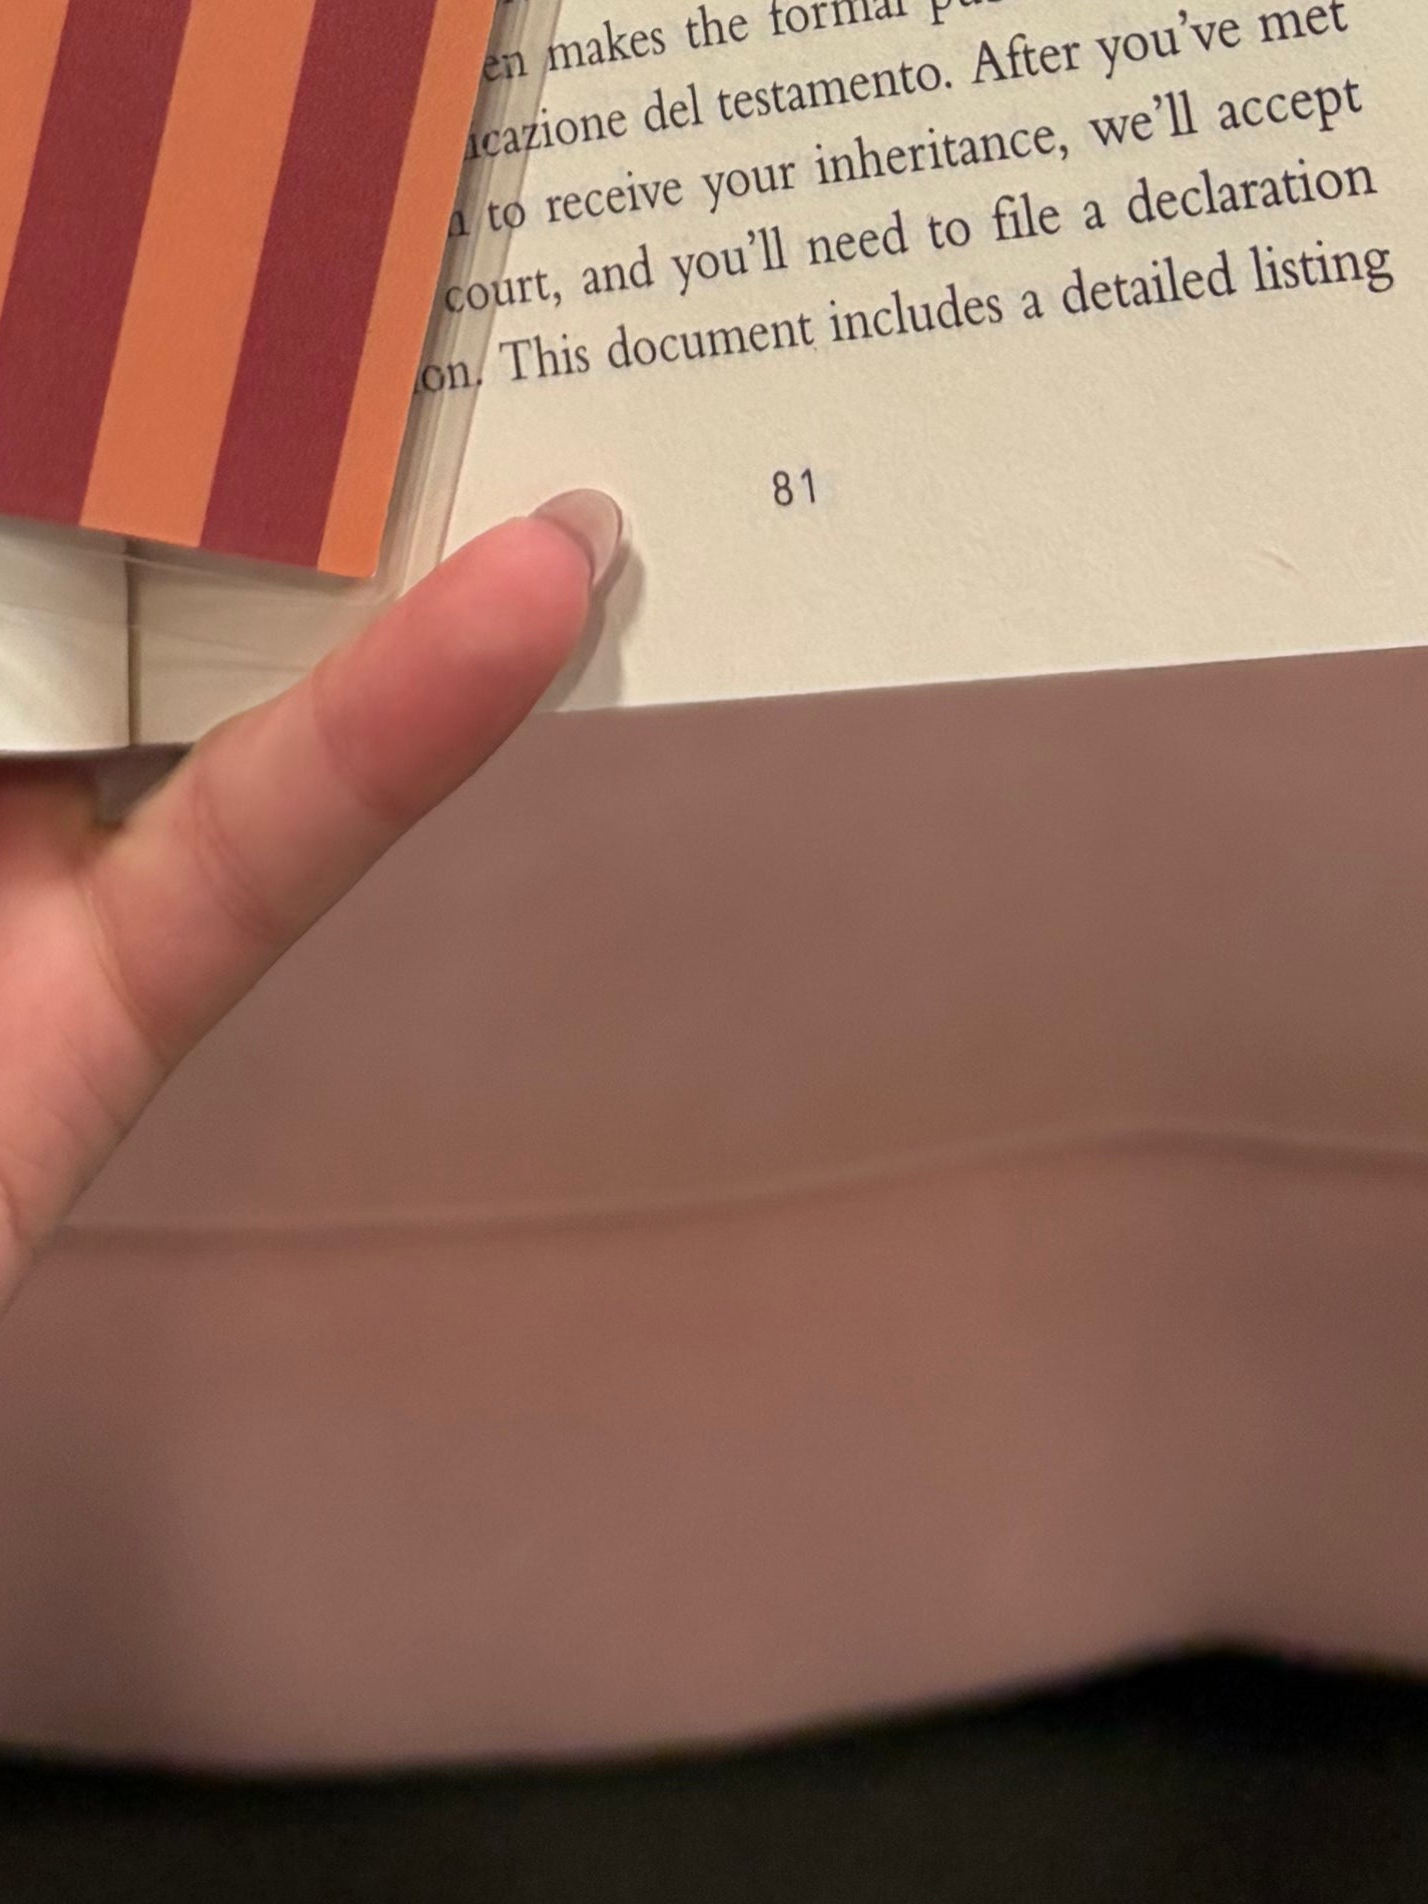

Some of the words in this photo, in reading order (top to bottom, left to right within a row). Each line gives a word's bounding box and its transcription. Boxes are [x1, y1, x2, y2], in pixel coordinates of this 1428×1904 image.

[644, 82, 704, 133] del
[717, 61, 953, 122] testamento.
[971, 32, 1081, 85] After
[1094, 9, 1242, 80] you’ve
[446, 269, 563, 315] court,
[582, 243, 655, 296] and
[670, 225, 789, 297] you’ll
[806, 208, 910, 266] need
[927, 215, 971, 250] to
[991, 191, 1061, 242] file
[1083, 200, 1107, 231] a
[1127, 157, 1379, 225] declaration
[498, 333, 590, 382] This
[608, 313, 816, 370] document
[829, 282, 1004, 343] includes
[1021, 289, 1045, 320] a
[1062, 248, 1238, 315] detailed
[1248, 239, 1395, 294] listing
[772, 470, 818, 508] 81
